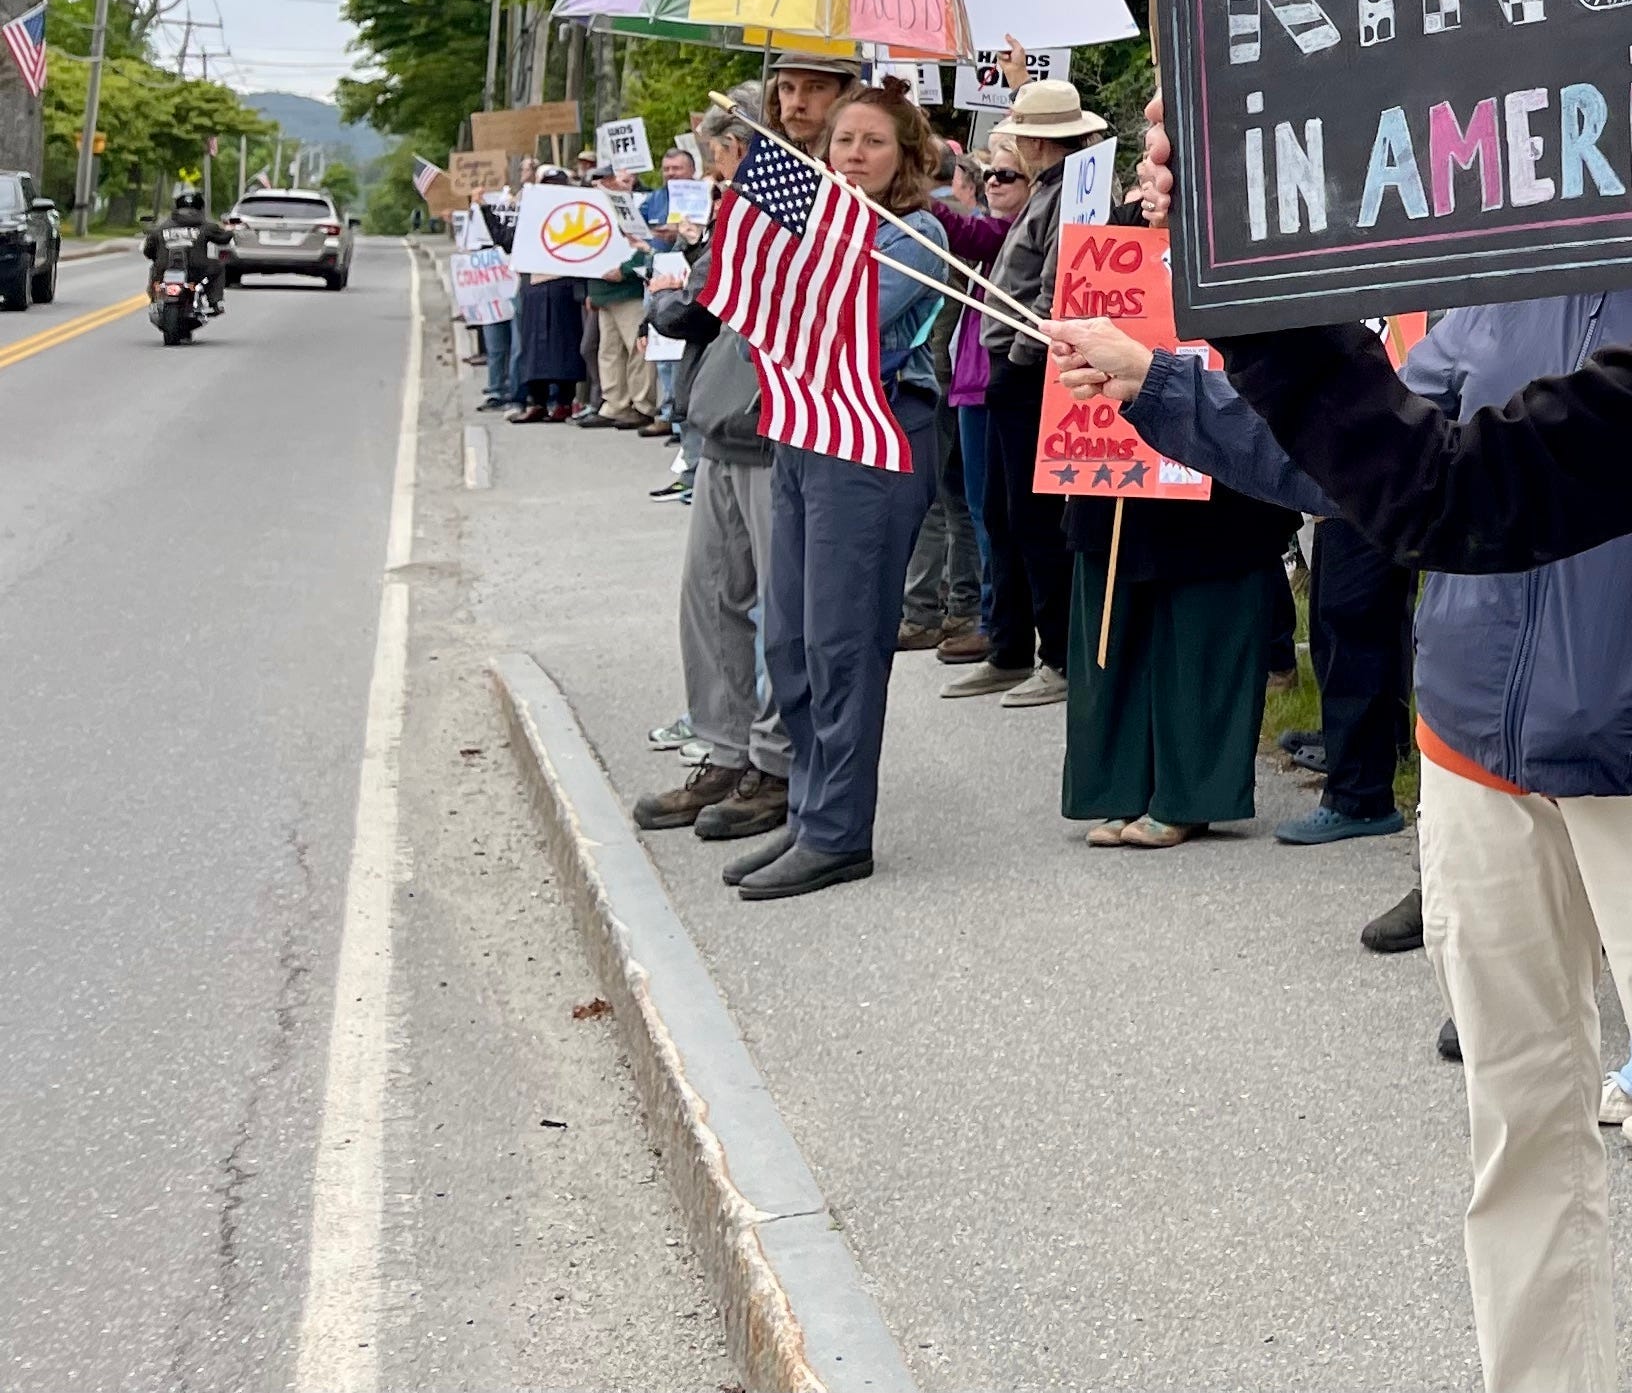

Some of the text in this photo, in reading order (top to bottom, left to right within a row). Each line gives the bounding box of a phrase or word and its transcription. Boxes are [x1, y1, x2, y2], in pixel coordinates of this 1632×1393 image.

[1076, 156, 1096, 204] NO
[1071, 236, 1143, 274] NO
[1060, 272, 1146, 318] Kings
[1057, 404, 1115, 433] NO
